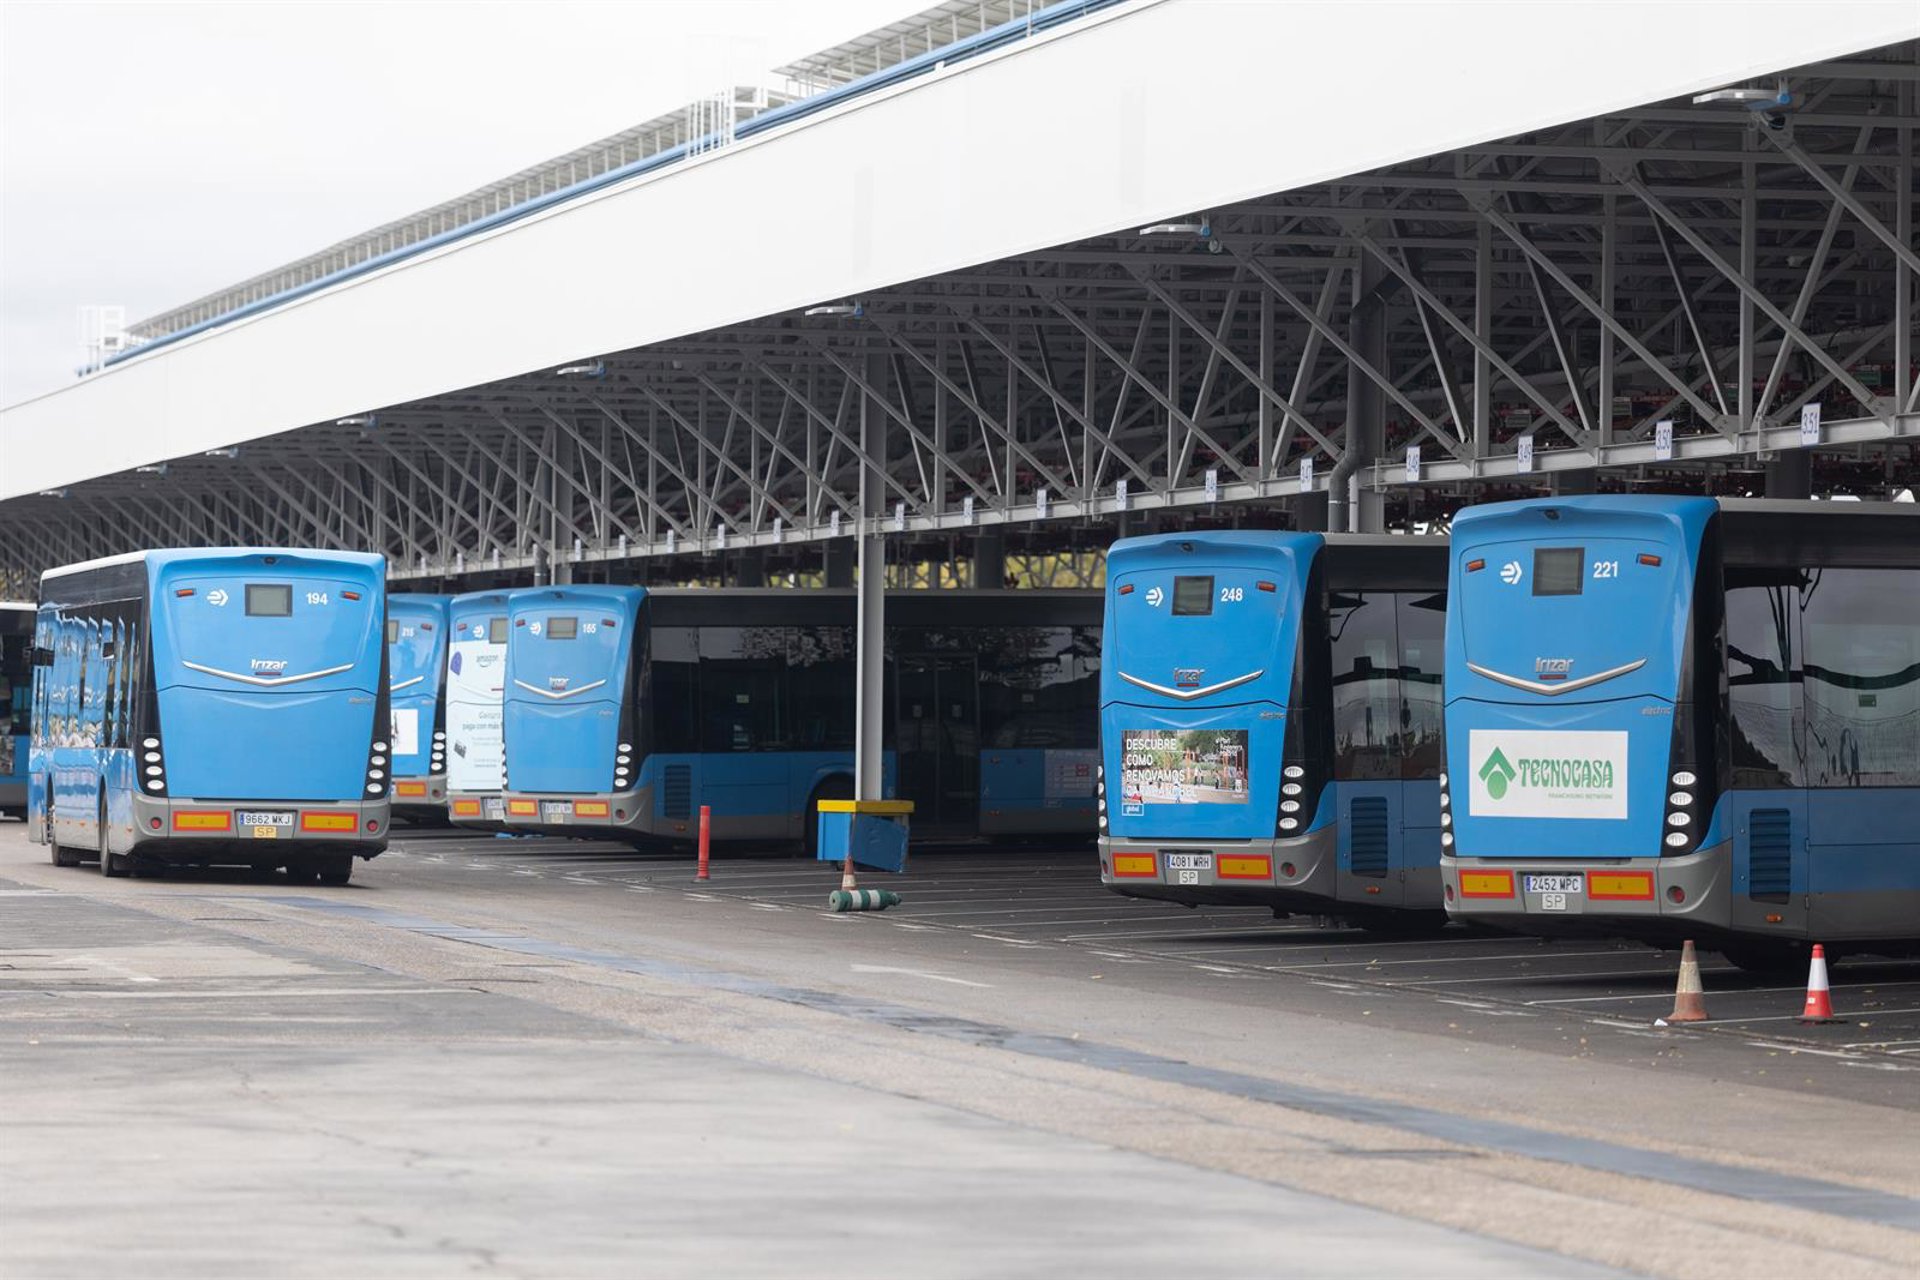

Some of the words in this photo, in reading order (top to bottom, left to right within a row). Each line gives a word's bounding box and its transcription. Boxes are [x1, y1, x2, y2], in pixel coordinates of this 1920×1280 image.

[1801, 412, 1818, 434] 3.51
[1593, 561, 1618, 578] 221
[306, 592, 328, 604] 194
[1221, 588, 1243, 602] 248
[1126, 738, 1178, 751] DESCUBRE
[1126, 769, 1186, 782] RENOVAMOS
[1518, 759, 1613, 788] TECNOCASA
[245, 814, 269, 824] 9662
[256, 827, 274, 837] SP
[1171, 856, 1190, 867] 4081
[1182, 871, 1196, 883] SP
[1532, 878, 1556, 891] 2452
[1559, 878, 1579, 891] MPC
[1545, 895, 1564, 908] SP
